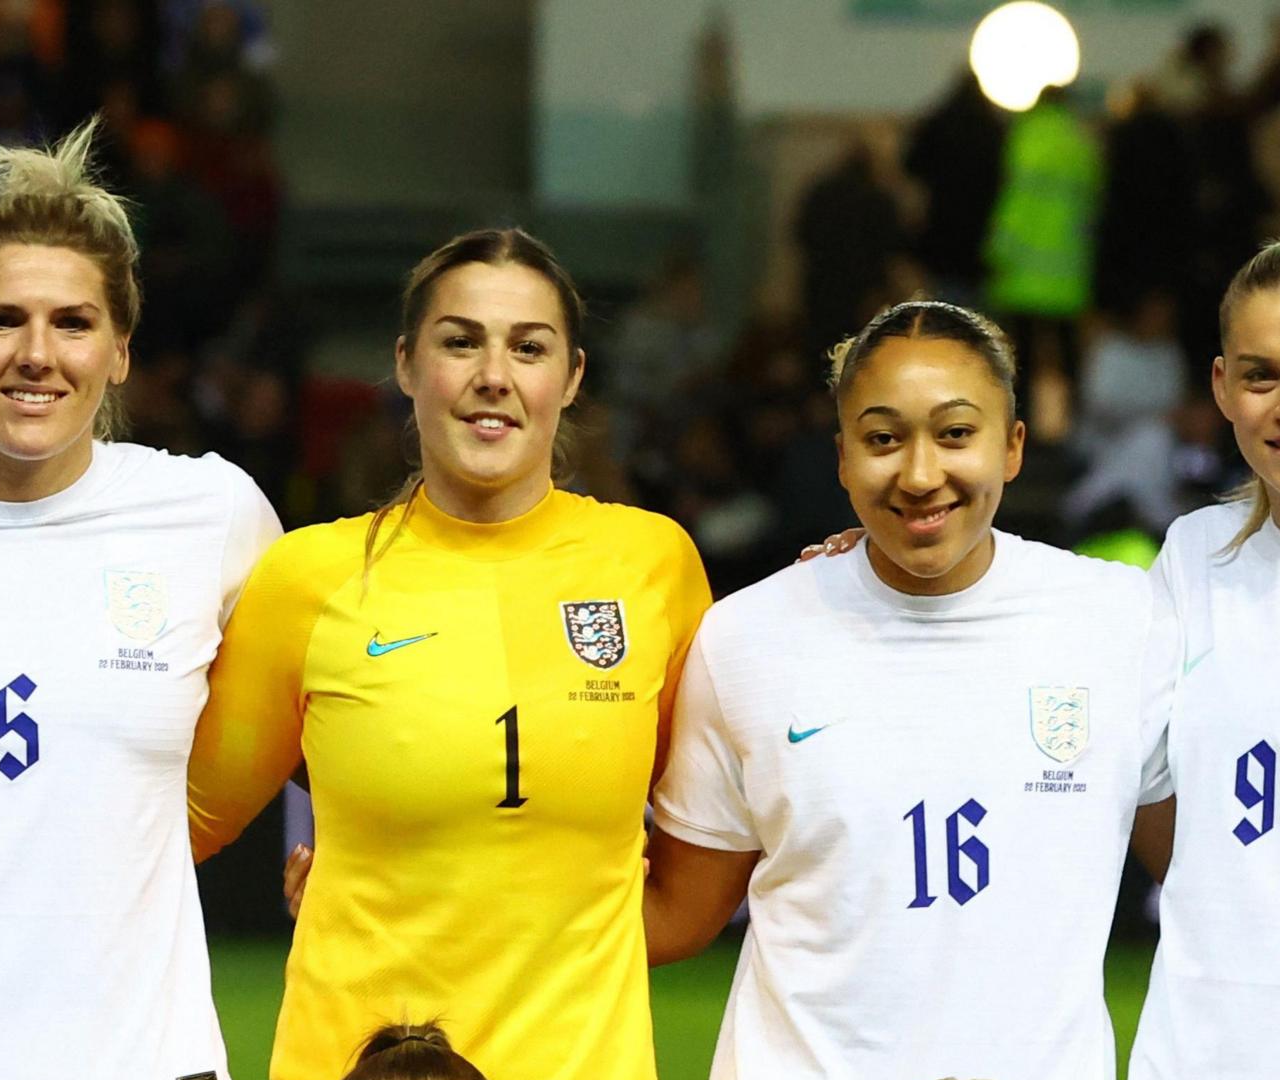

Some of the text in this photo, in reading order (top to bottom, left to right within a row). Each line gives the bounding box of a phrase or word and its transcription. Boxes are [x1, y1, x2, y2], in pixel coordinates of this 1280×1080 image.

[118, 648, 153, 659] BELGIUM
[110, 660, 152, 671] FEBRUARY
[586, 680, 620, 690] BELGIUM
[579, 692, 621, 702] FEBRUARY
[495, 706, 528, 809] 1
[1043, 770, 1074, 780] BELGIUM
[1035, 782, 1071, 792] FEBRUARY
[1232, 739, 1277, 847] 9
[903, 798, 990, 909] 16
